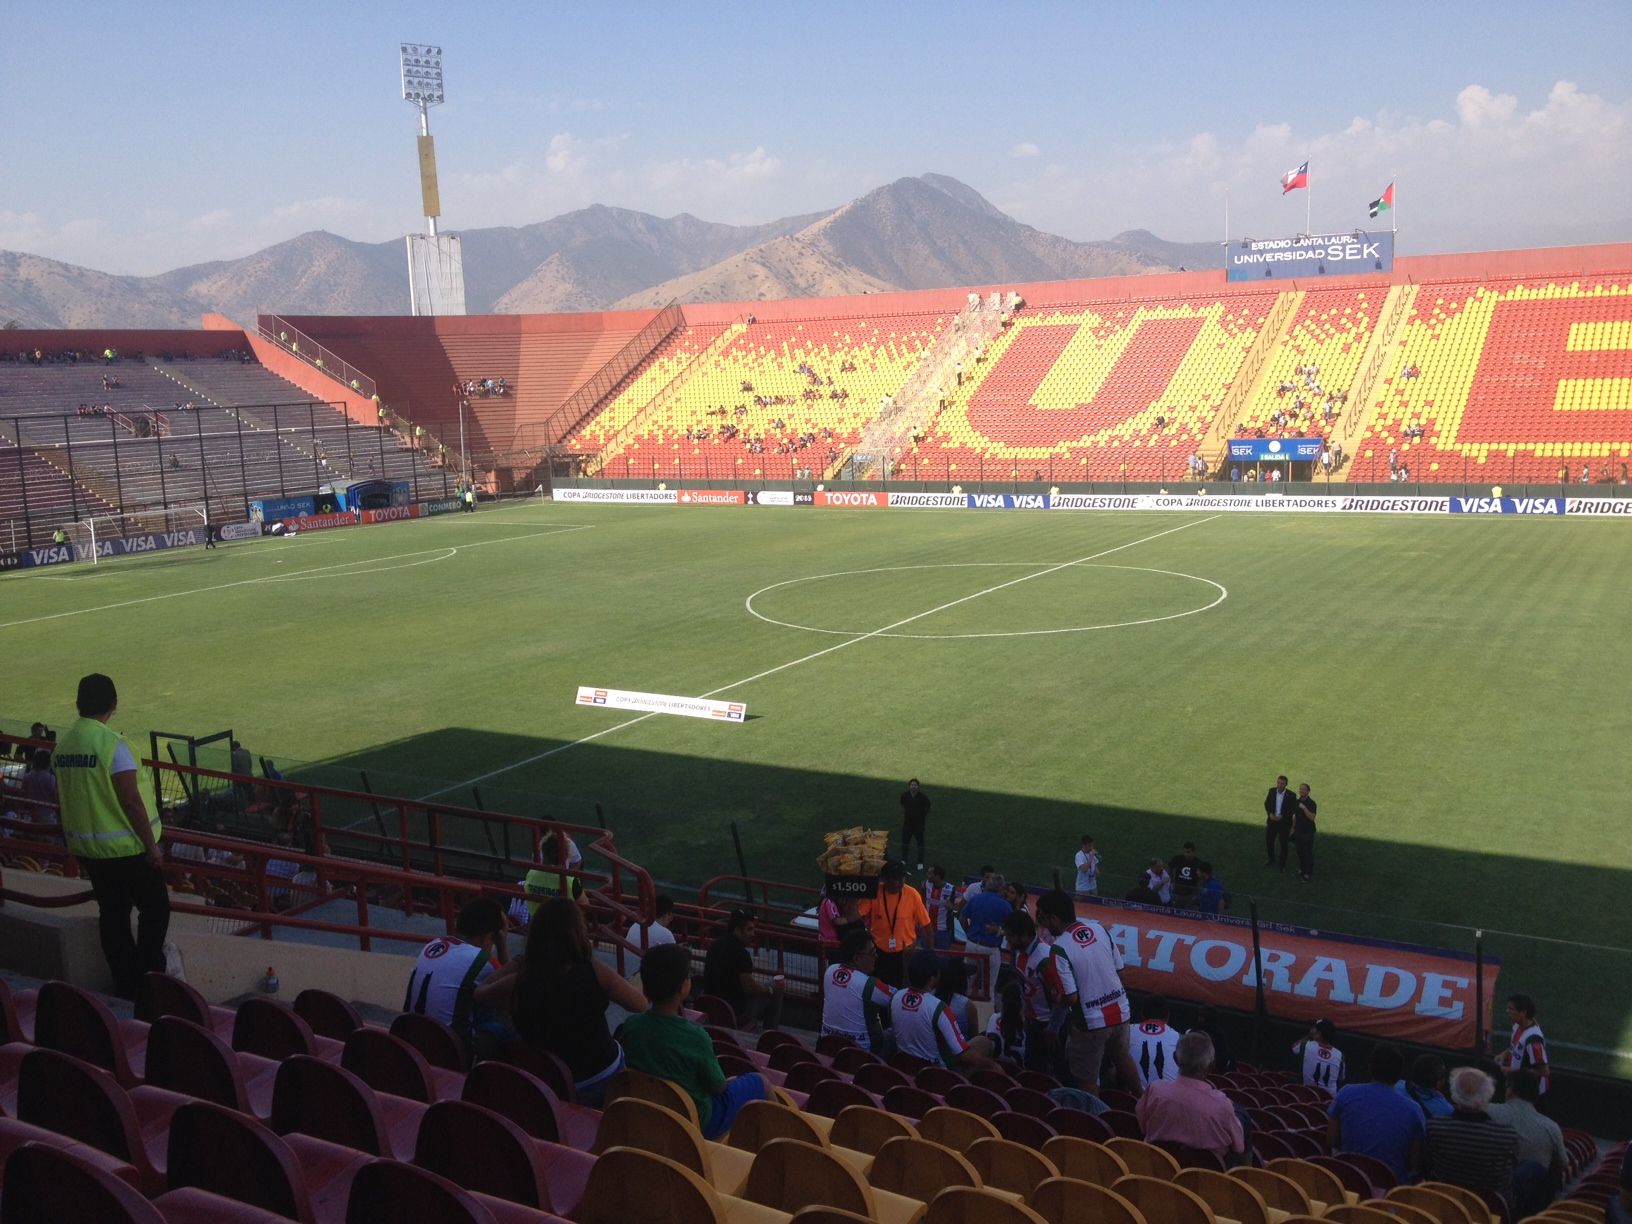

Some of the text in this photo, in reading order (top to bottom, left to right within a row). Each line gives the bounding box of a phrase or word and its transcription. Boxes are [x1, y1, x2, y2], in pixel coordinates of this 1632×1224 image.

[1251, 240, 1292, 250] ESTADIO
[1234, 243, 1380, 264] UNIVERSIDAD SEK
[582, 491, 625, 499] BRIDGESTONE
[692, 492, 739, 503] Santander
[825, 493, 878, 506] TOYOTA
[890, 495, 967, 506] BRIDGESTONE
[972, 494, 1045, 509] VISA VISA
[429, 501, 461, 513] CONMEBO
[1052, 496, 1139, 509] BRIDGESTONE
[1156, 499, 1337, 509] COPA BRIDGESTONE LIBERTADORES
[1341, 498, 1448, 512] BRIDGESTONE
[1456, 498, 1558, 514] VISA VISA
[369, 506, 410, 522] TOYOTA
[300, 513, 349, 530] Santander
[120, 535, 156, 553] VISA
[163, 530, 196, 547] VISA
[30, 547, 69, 565] VISA
[832, 882, 867, 892] $1.500
[1076, 916, 1470, 1020] ATORADE
